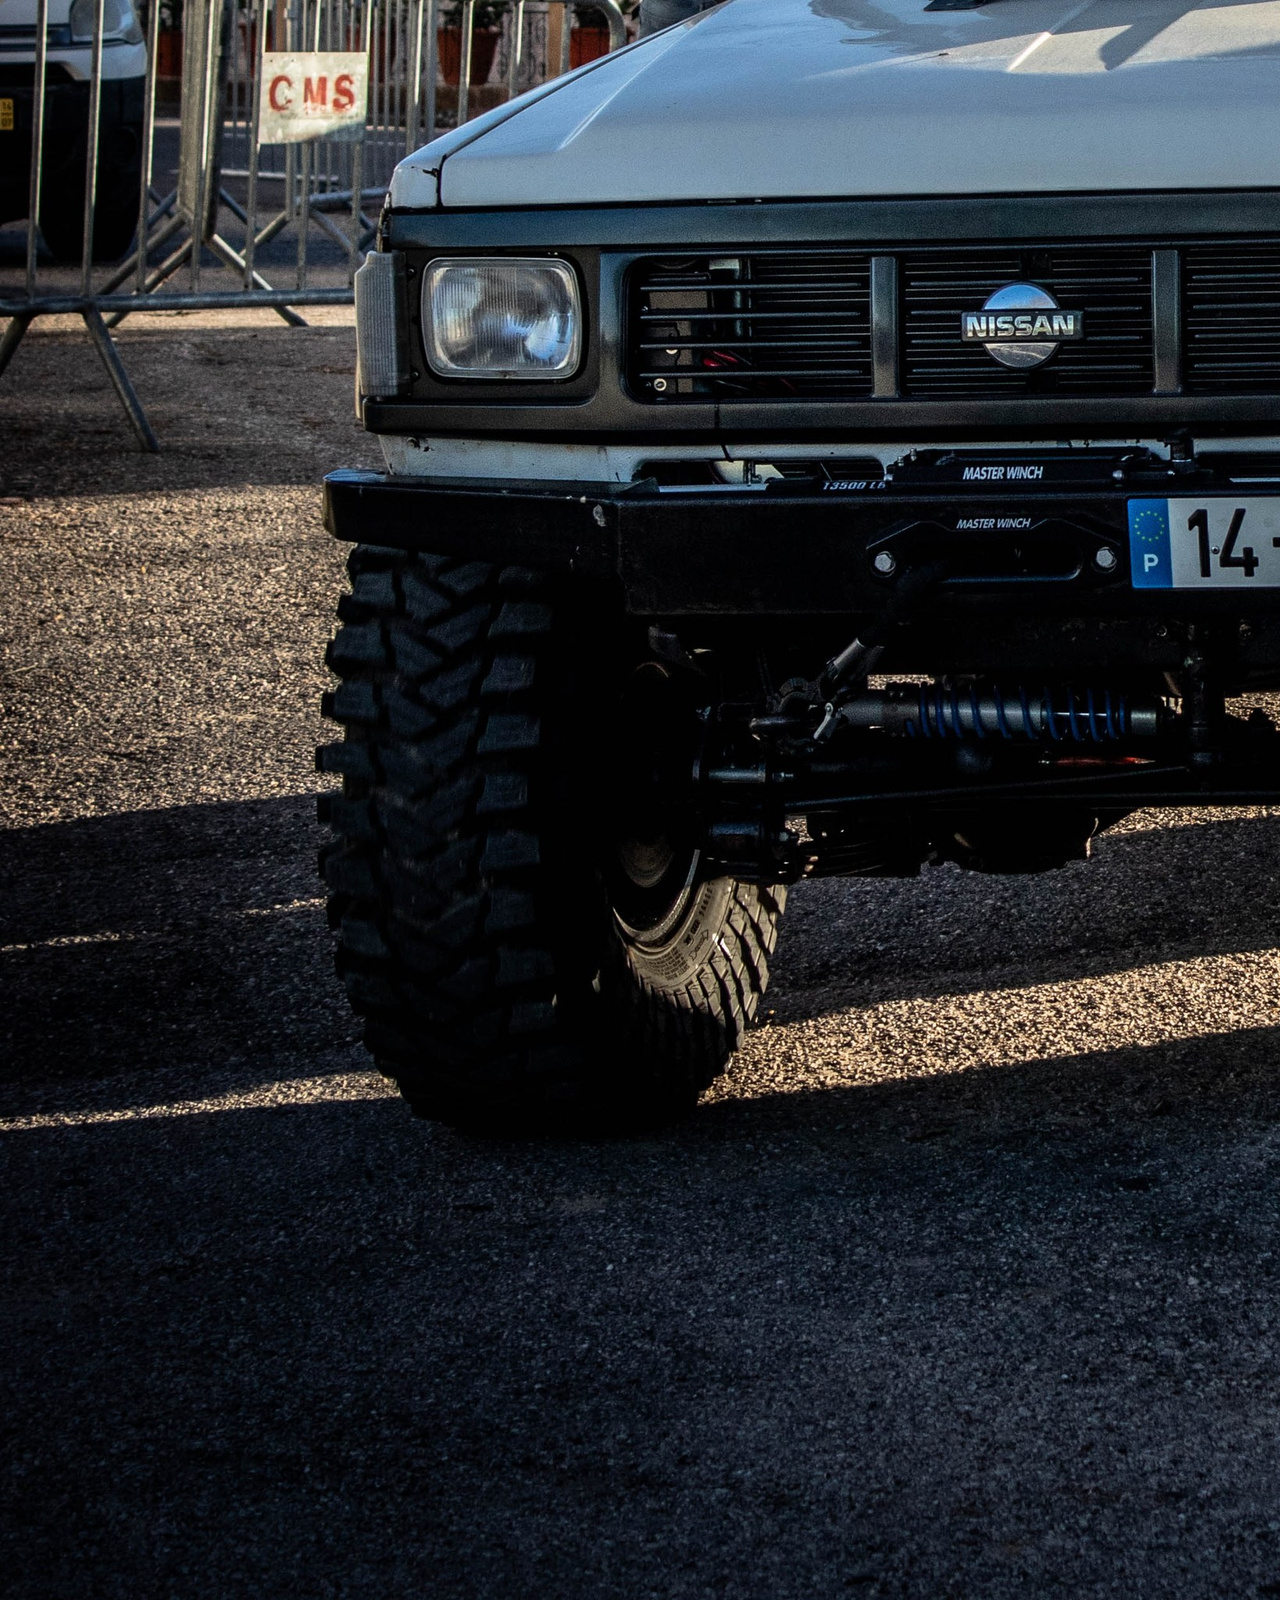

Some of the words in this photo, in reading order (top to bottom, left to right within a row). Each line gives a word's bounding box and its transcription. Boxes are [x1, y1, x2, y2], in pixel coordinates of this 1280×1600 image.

[268, 74, 356, 112] CMS
[966, 314, 1075, 338] NISSAN
[962, 466, 1004, 480] MASTER
[1006, 466, 1044, 480] WINCH
[822, 481, 868, 491] 13500
[956, 518, 995, 529] MASTER
[997, 517, 1032, 529] WINCH
[1143, 553, 1159, 573] P
